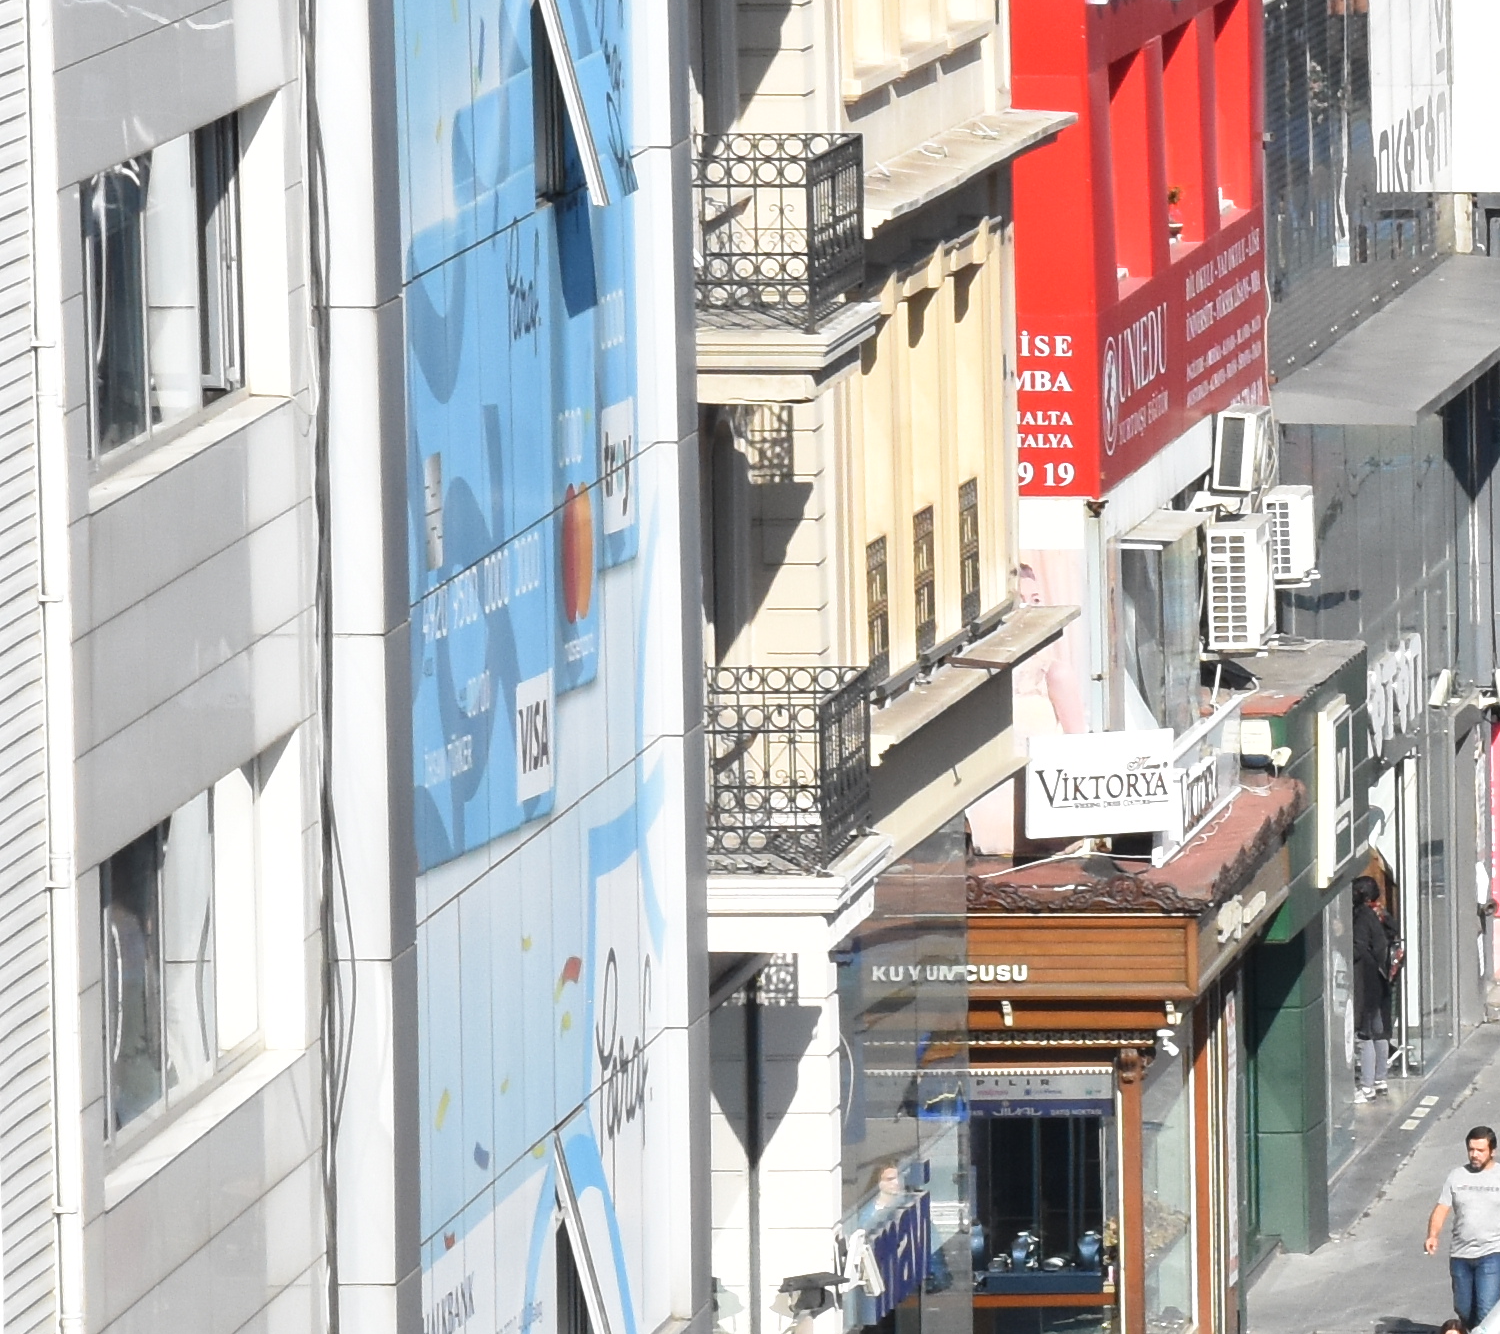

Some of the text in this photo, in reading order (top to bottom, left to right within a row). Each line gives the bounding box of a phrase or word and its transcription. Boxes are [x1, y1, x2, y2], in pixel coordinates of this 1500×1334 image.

[1020, 329, 1073, 357] İSE
[1016, 410, 1073, 426] ALTA
[1044, 462, 1075, 487] 19
[519, 699, 550, 775] VISA
[1035, 768, 1169, 809] VİKTORYA
